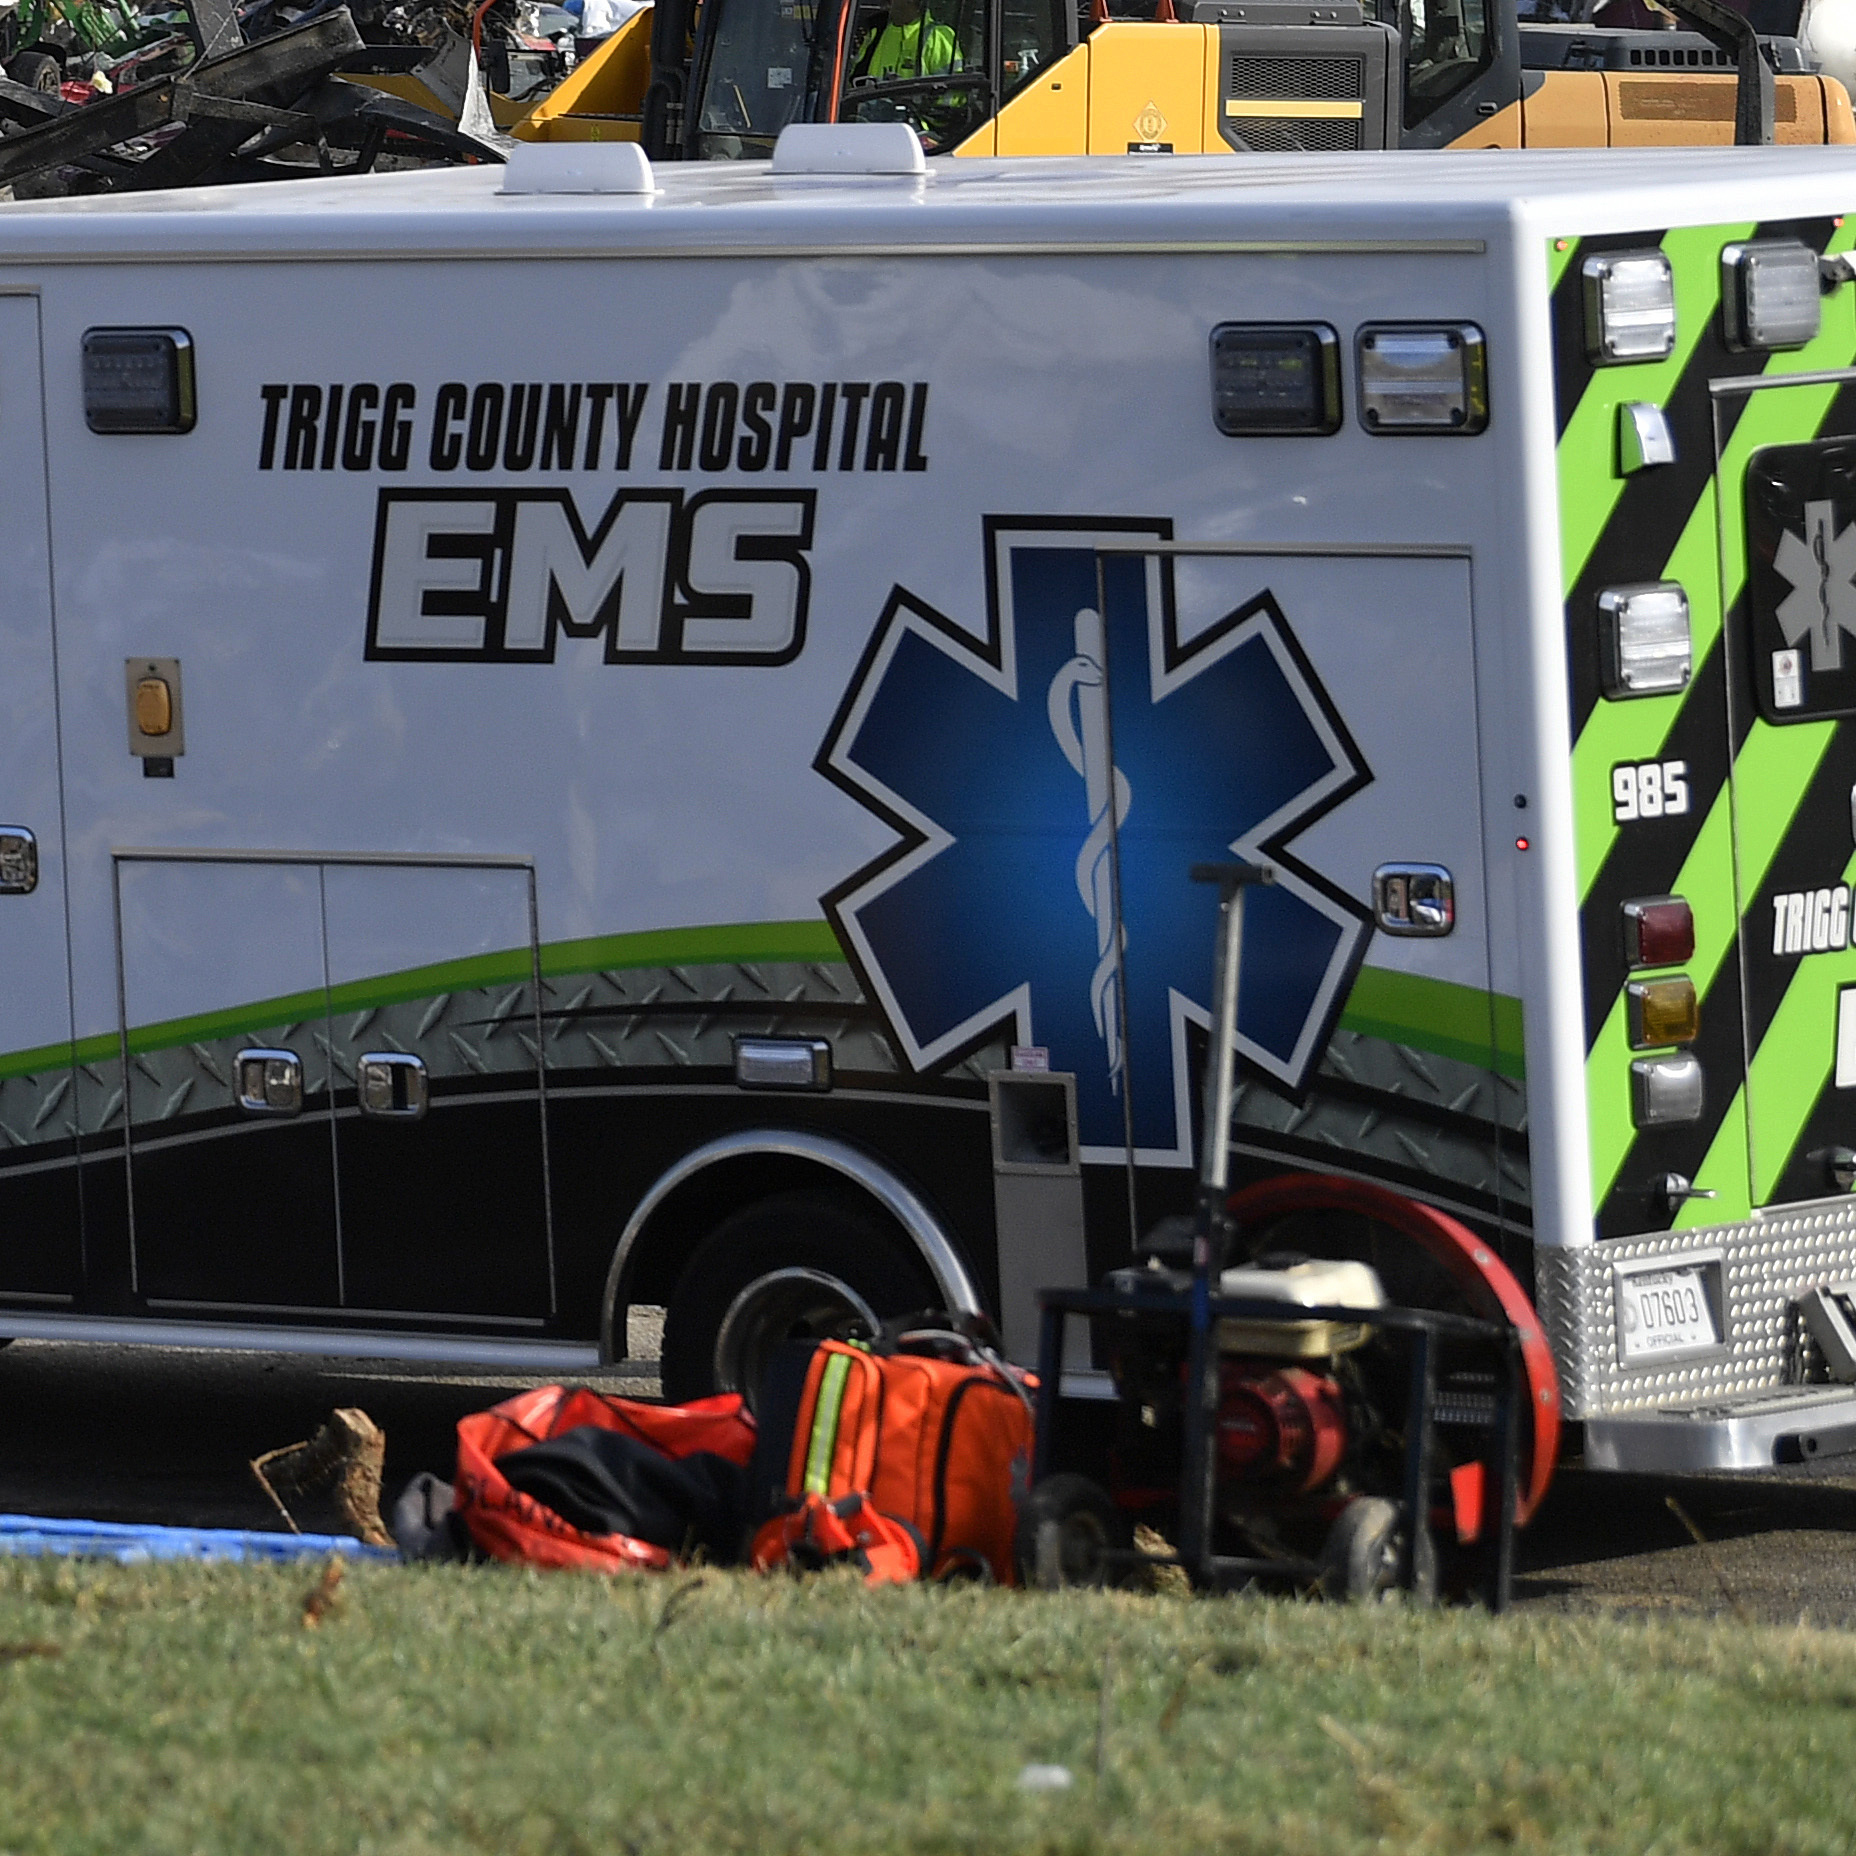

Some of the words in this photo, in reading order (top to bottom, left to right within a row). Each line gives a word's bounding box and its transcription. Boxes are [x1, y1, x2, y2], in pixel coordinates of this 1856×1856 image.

[257, 382, 416, 472] TRIGG
[429, 382, 649, 472] COUNTY
[657, 382, 930, 473] HOSPITAL
[363, 487, 818, 667] EMS
[1610, 760, 1690, 824] 985
[1772, 885, 1849, 957] TRIGG
[1639, 1287, 1699, 1329] 07603
[1646, 1332, 1684, 1347] OFFICIAL
